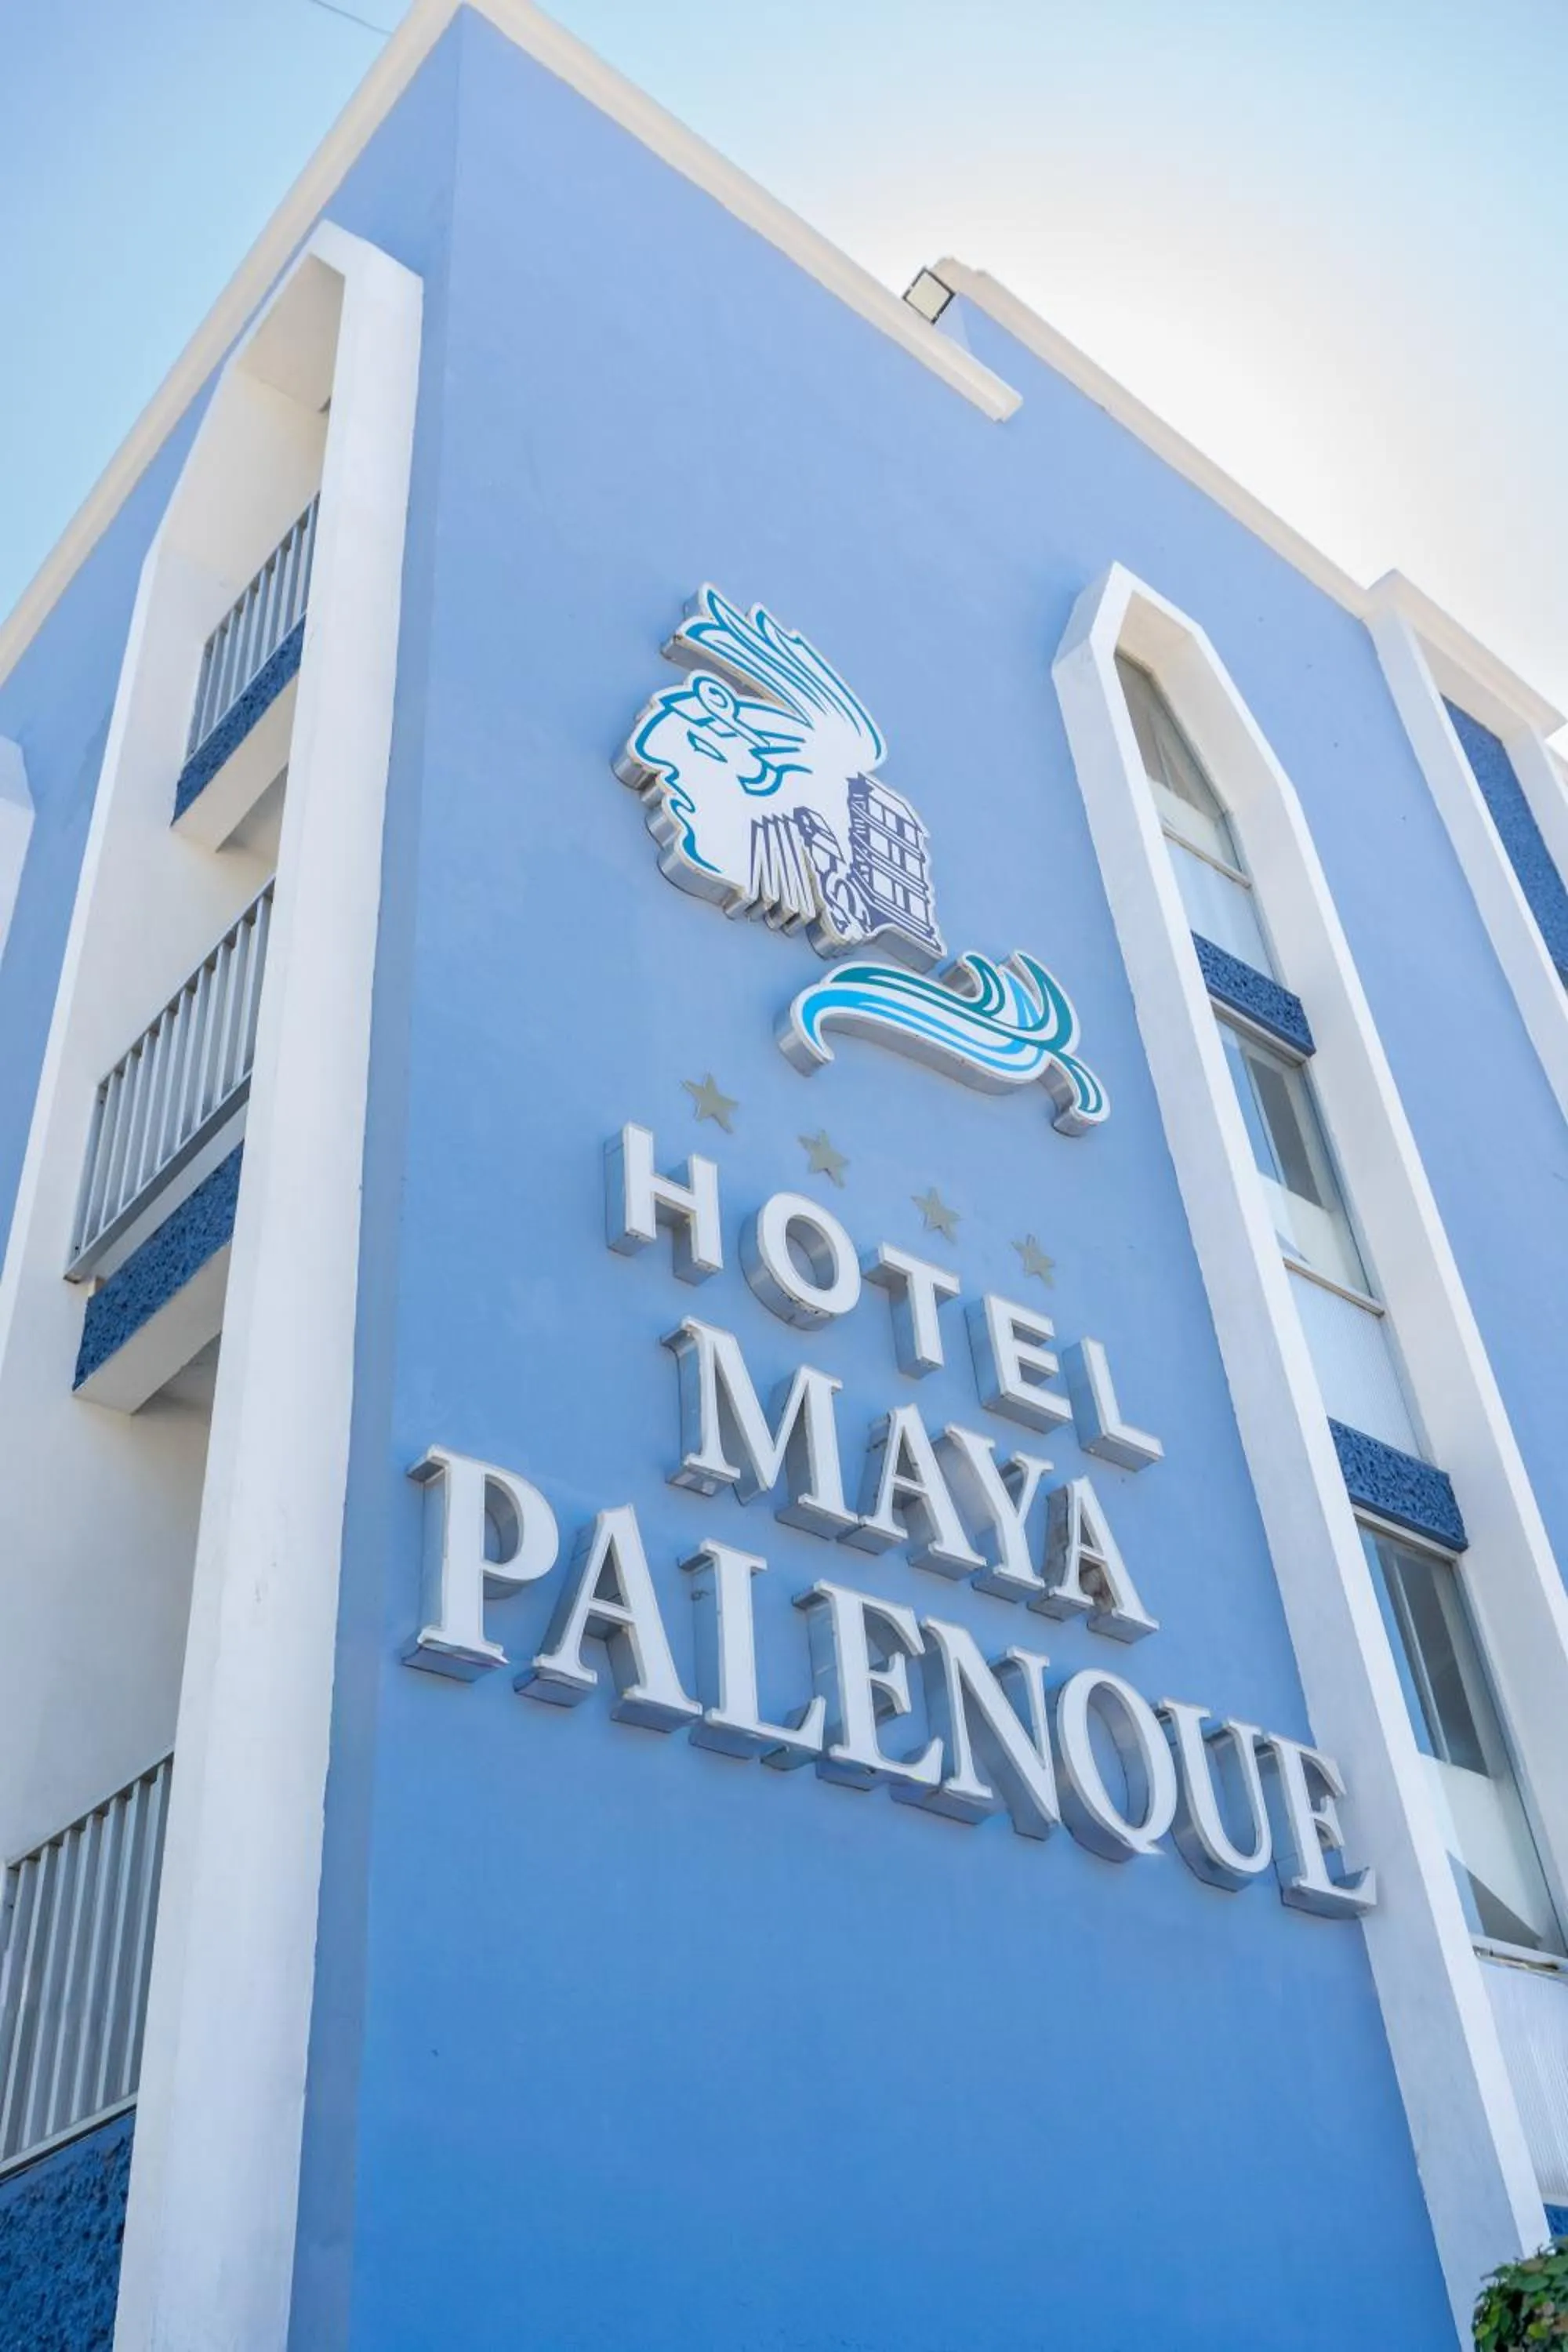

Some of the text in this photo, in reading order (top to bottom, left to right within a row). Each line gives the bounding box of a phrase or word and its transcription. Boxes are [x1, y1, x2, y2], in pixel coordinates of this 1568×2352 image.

[615, 1123, 1163, 1461] HOTEL
[670, 1316, 1159, 1635] MAYA
[409, 1446, 1377, 1911] PALENQUE
